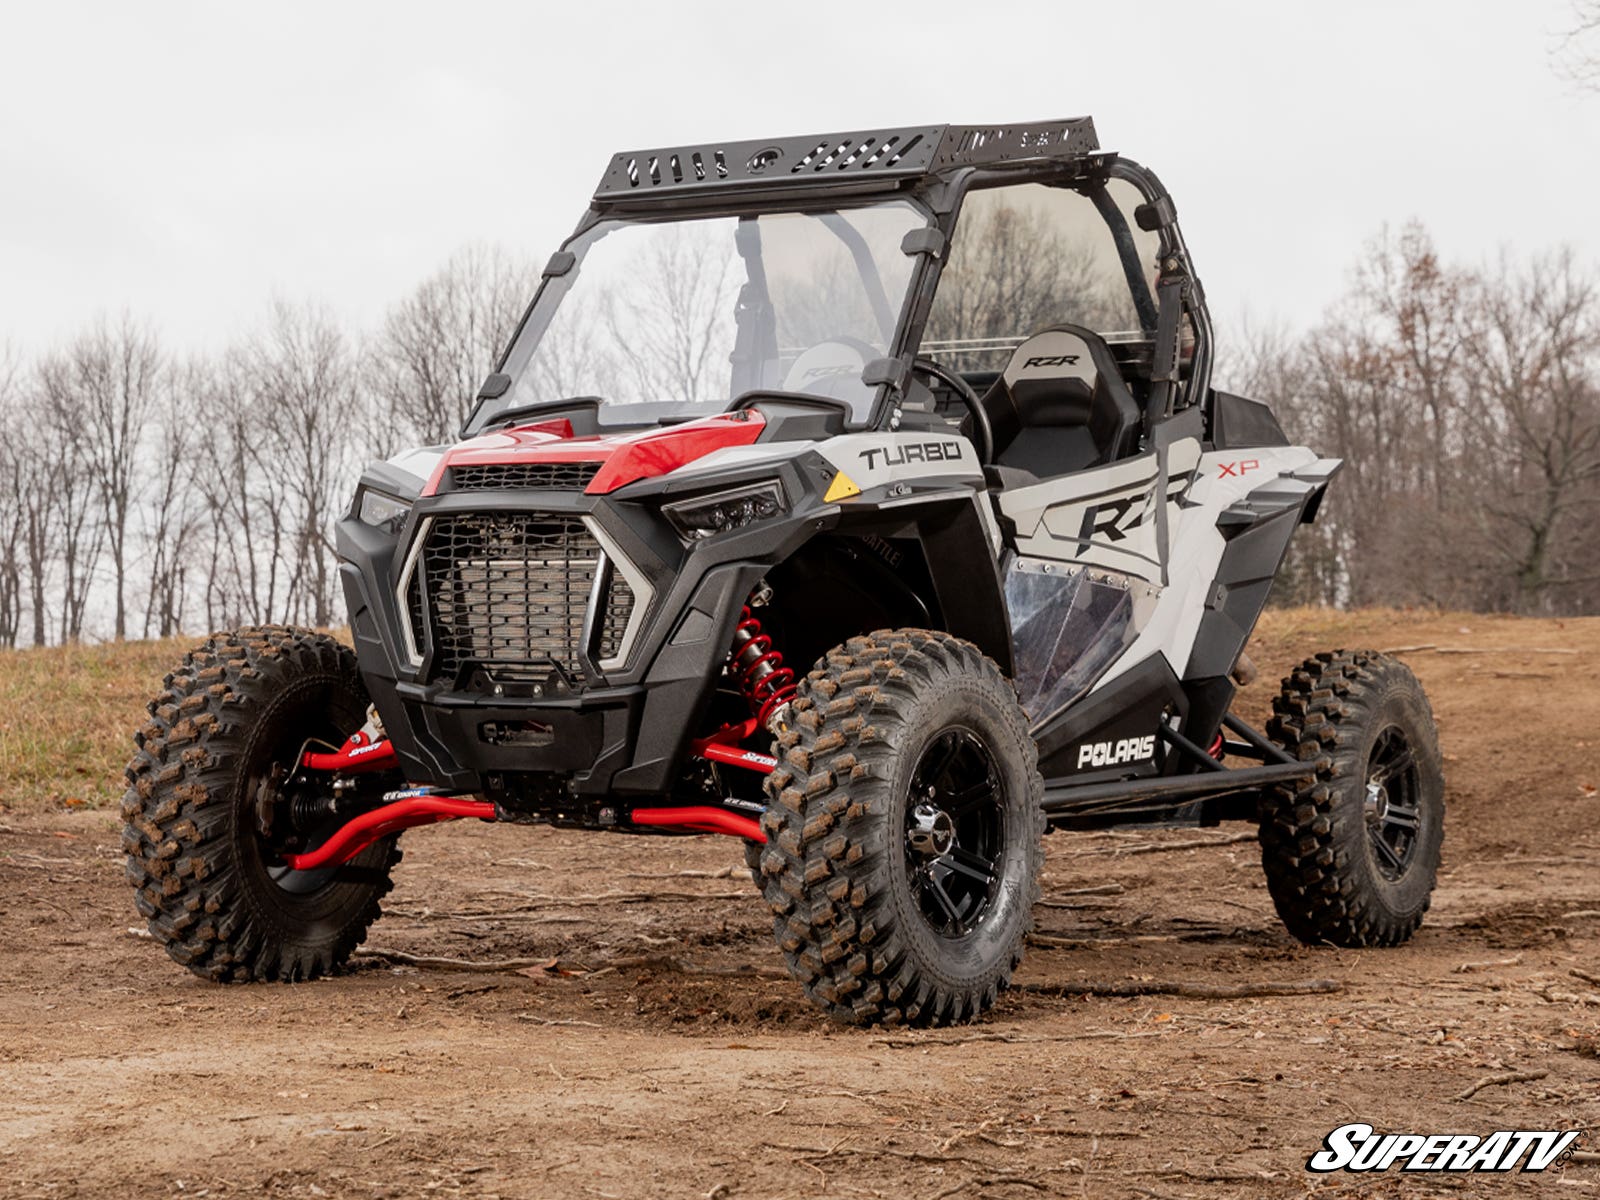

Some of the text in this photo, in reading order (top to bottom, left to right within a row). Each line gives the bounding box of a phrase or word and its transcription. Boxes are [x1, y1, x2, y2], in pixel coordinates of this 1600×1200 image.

[1022, 355, 1080, 370] RZR
[859, 441, 962, 470] TURBO
[1217, 460, 1259, 479] XP
[1077, 735, 1156, 769] POLARIS
